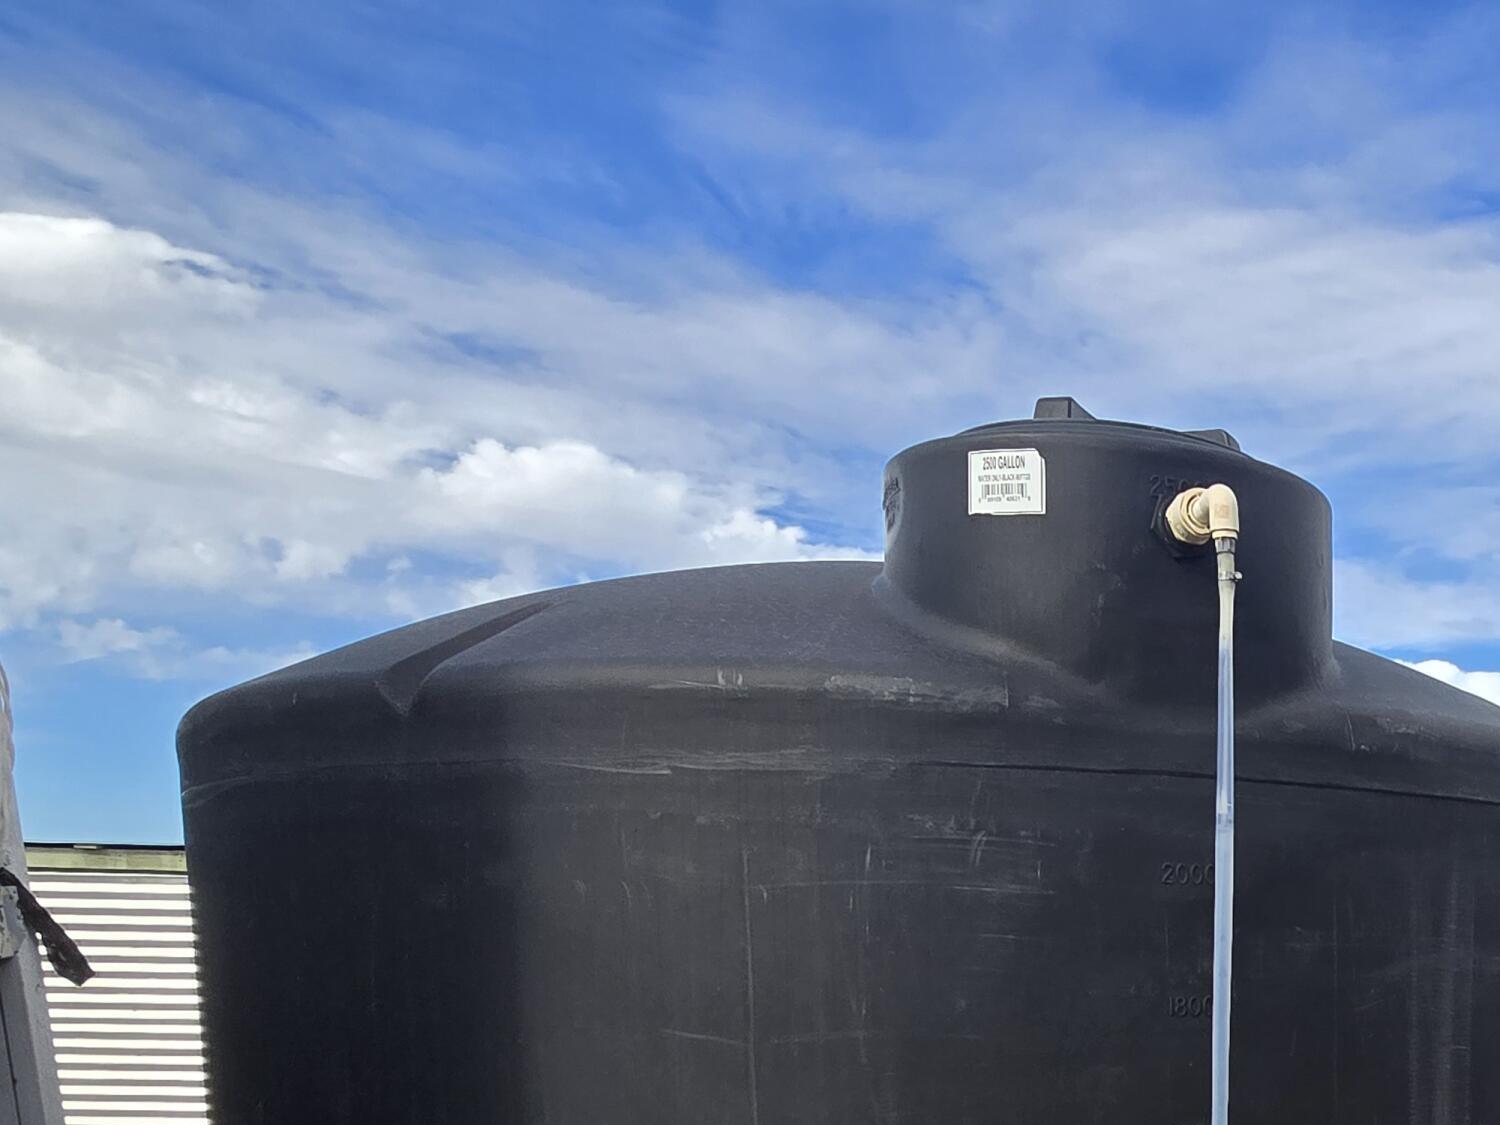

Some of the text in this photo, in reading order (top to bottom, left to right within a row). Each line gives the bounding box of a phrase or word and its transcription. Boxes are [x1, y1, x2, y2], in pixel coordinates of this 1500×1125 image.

[982, 455, 1026, 470] 2500 GALLON
[1160, 862, 1215, 886] 2000
